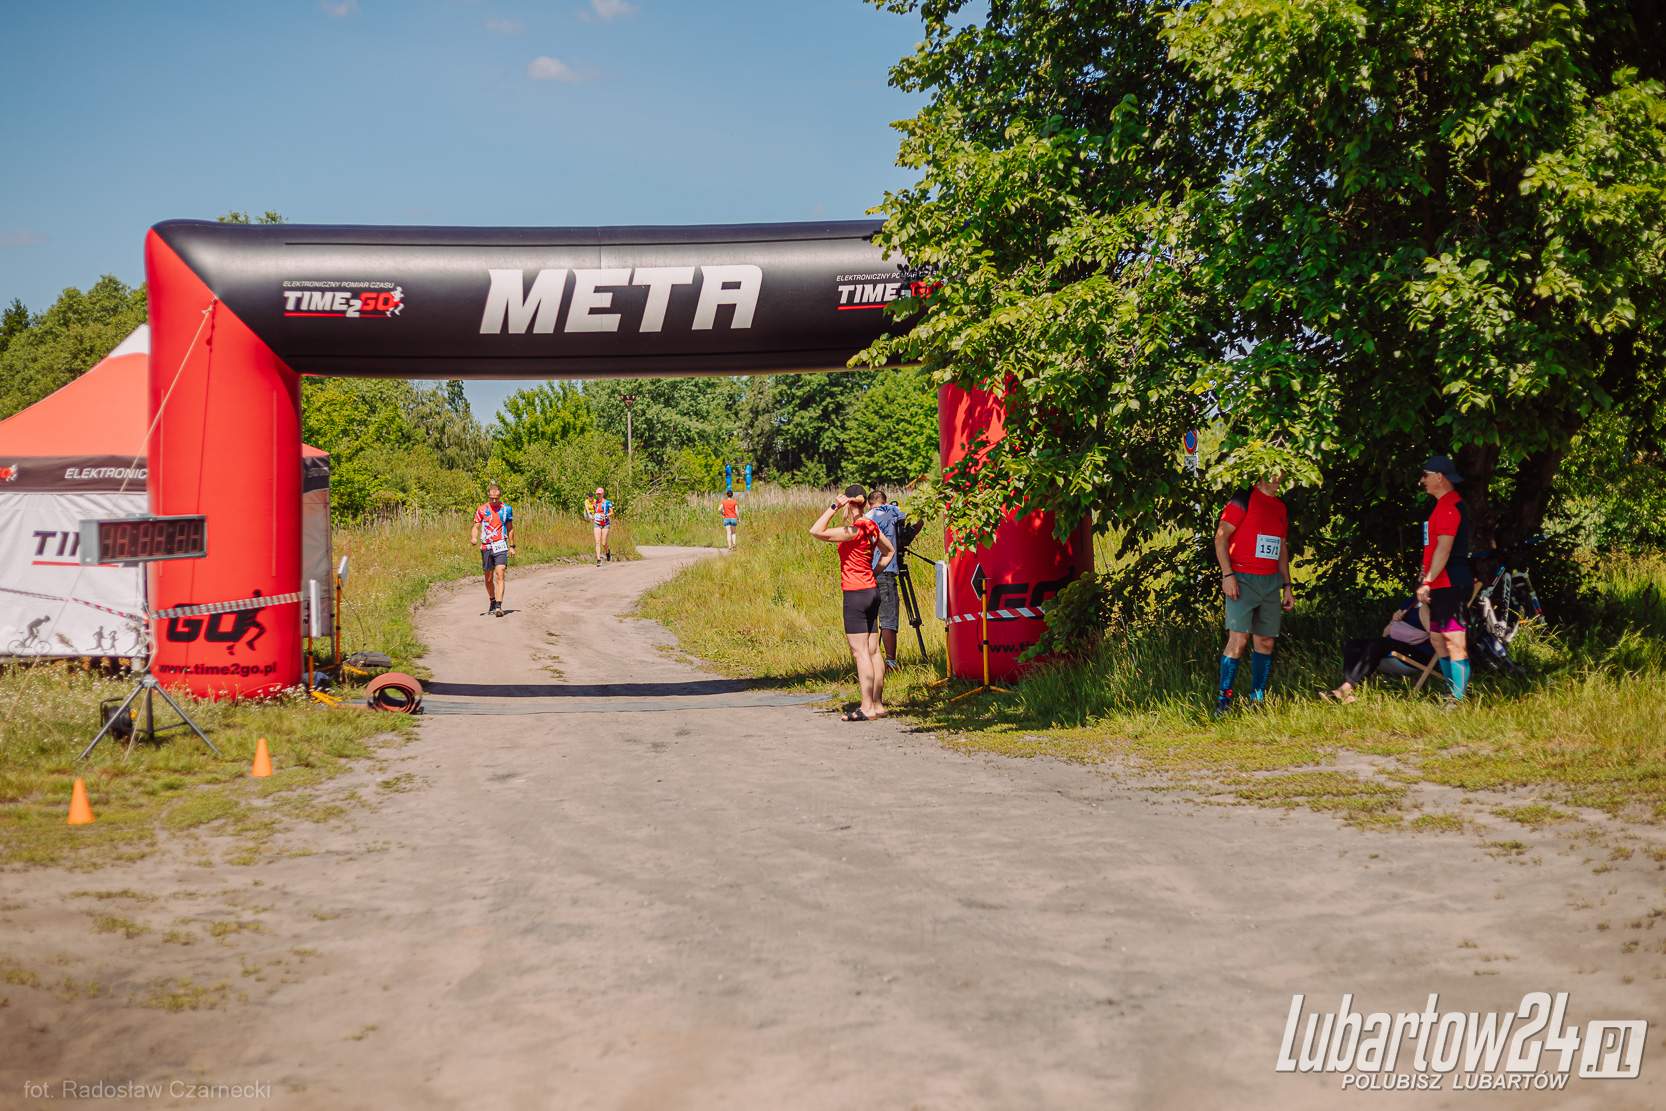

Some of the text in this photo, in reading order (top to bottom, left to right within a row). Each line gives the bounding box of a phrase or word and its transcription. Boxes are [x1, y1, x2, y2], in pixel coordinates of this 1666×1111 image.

[282, 280, 340, 288] ELEKTRONICZNY
[836, 273, 890, 282] ELEKTRONICZNY
[283, 291, 397, 318] TIME2GO
[480, 264, 763, 334] META
